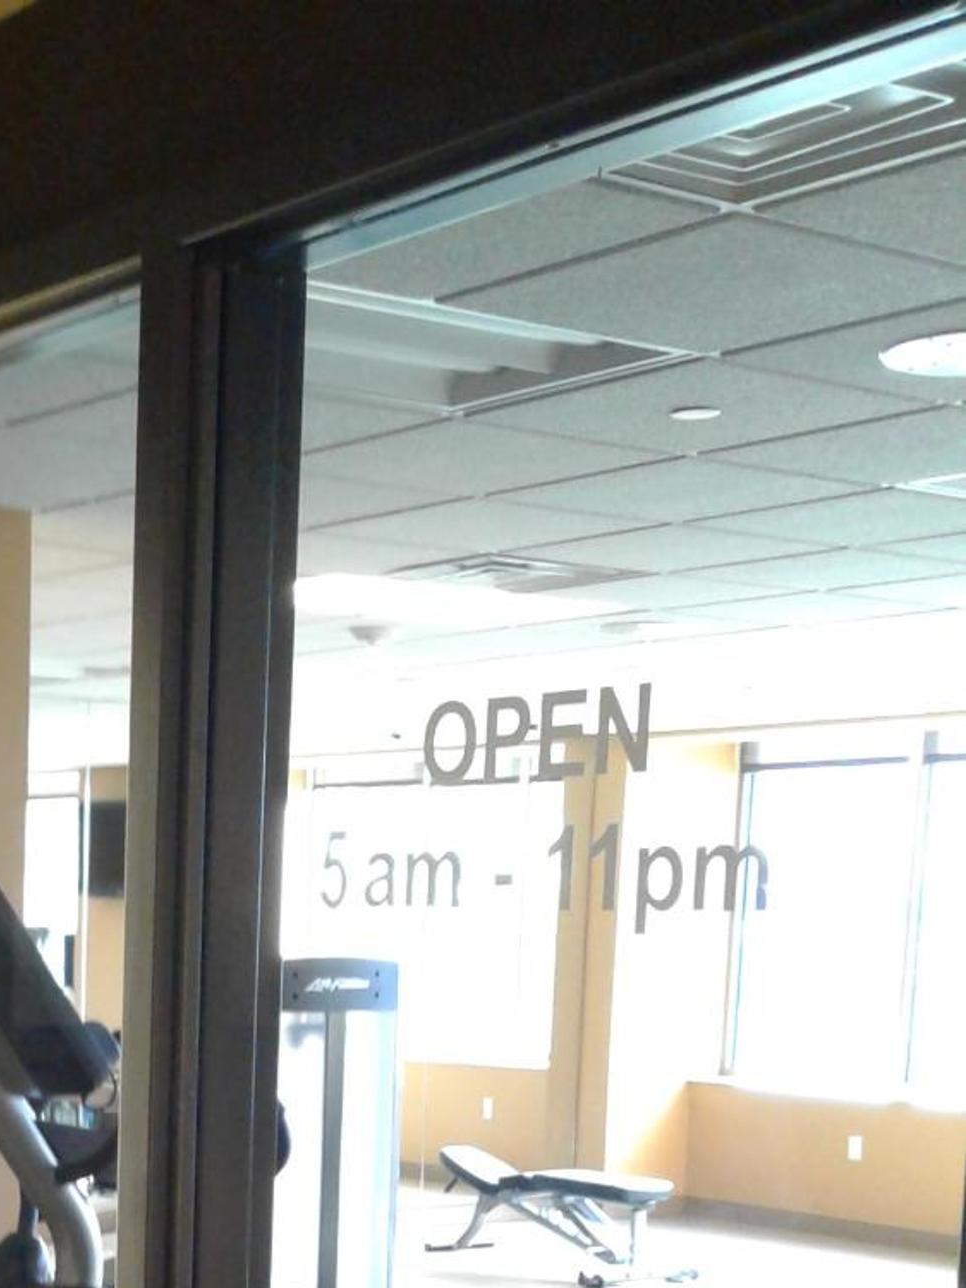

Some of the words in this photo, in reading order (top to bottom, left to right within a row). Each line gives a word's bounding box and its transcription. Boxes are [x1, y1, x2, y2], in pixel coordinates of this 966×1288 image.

[424, 683, 651, 785] OPEN
[321, 832, 461, 908] 5am
[548, 823, 767, 934] 11pm
